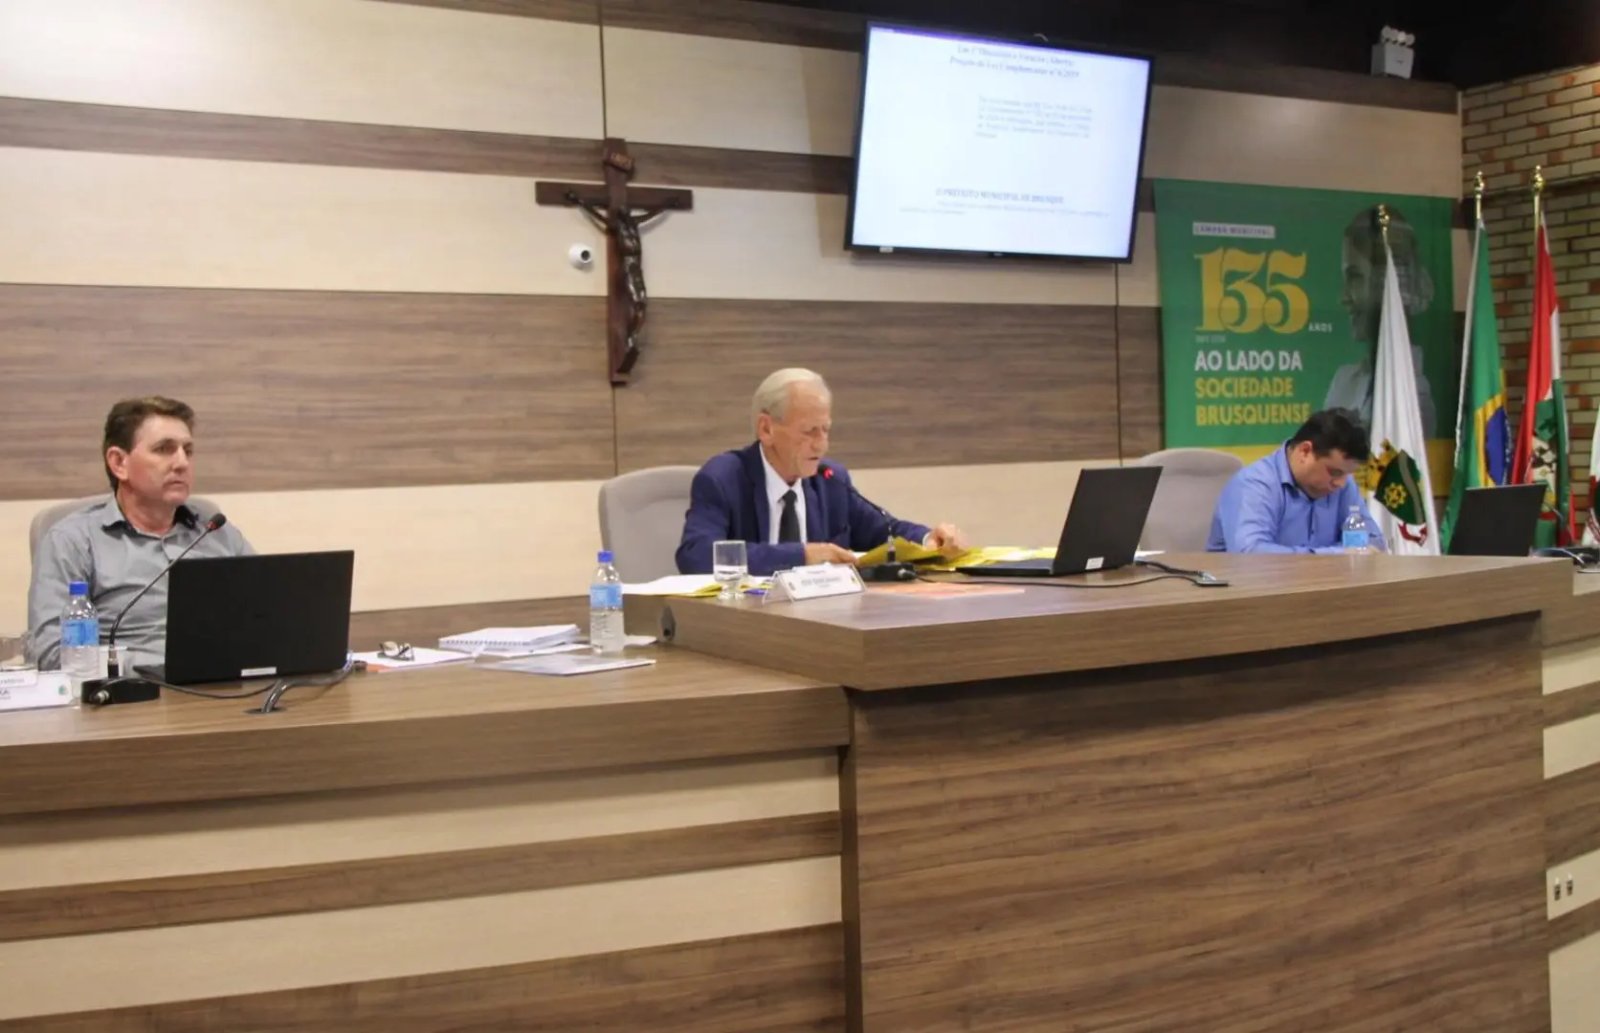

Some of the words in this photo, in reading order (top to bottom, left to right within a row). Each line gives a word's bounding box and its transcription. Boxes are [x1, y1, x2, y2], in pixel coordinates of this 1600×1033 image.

[1309, 322, 1333, 333] ANOS
[1195, 350, 1222, 371] AO
[1226, 351, 1275, 371] LADO
[1278, 352, 1303, 371] DA
[1195, 377, 1294, 397] SOCIEDADE
[1196, 403, 1311, 426] BRUSQUENSE
